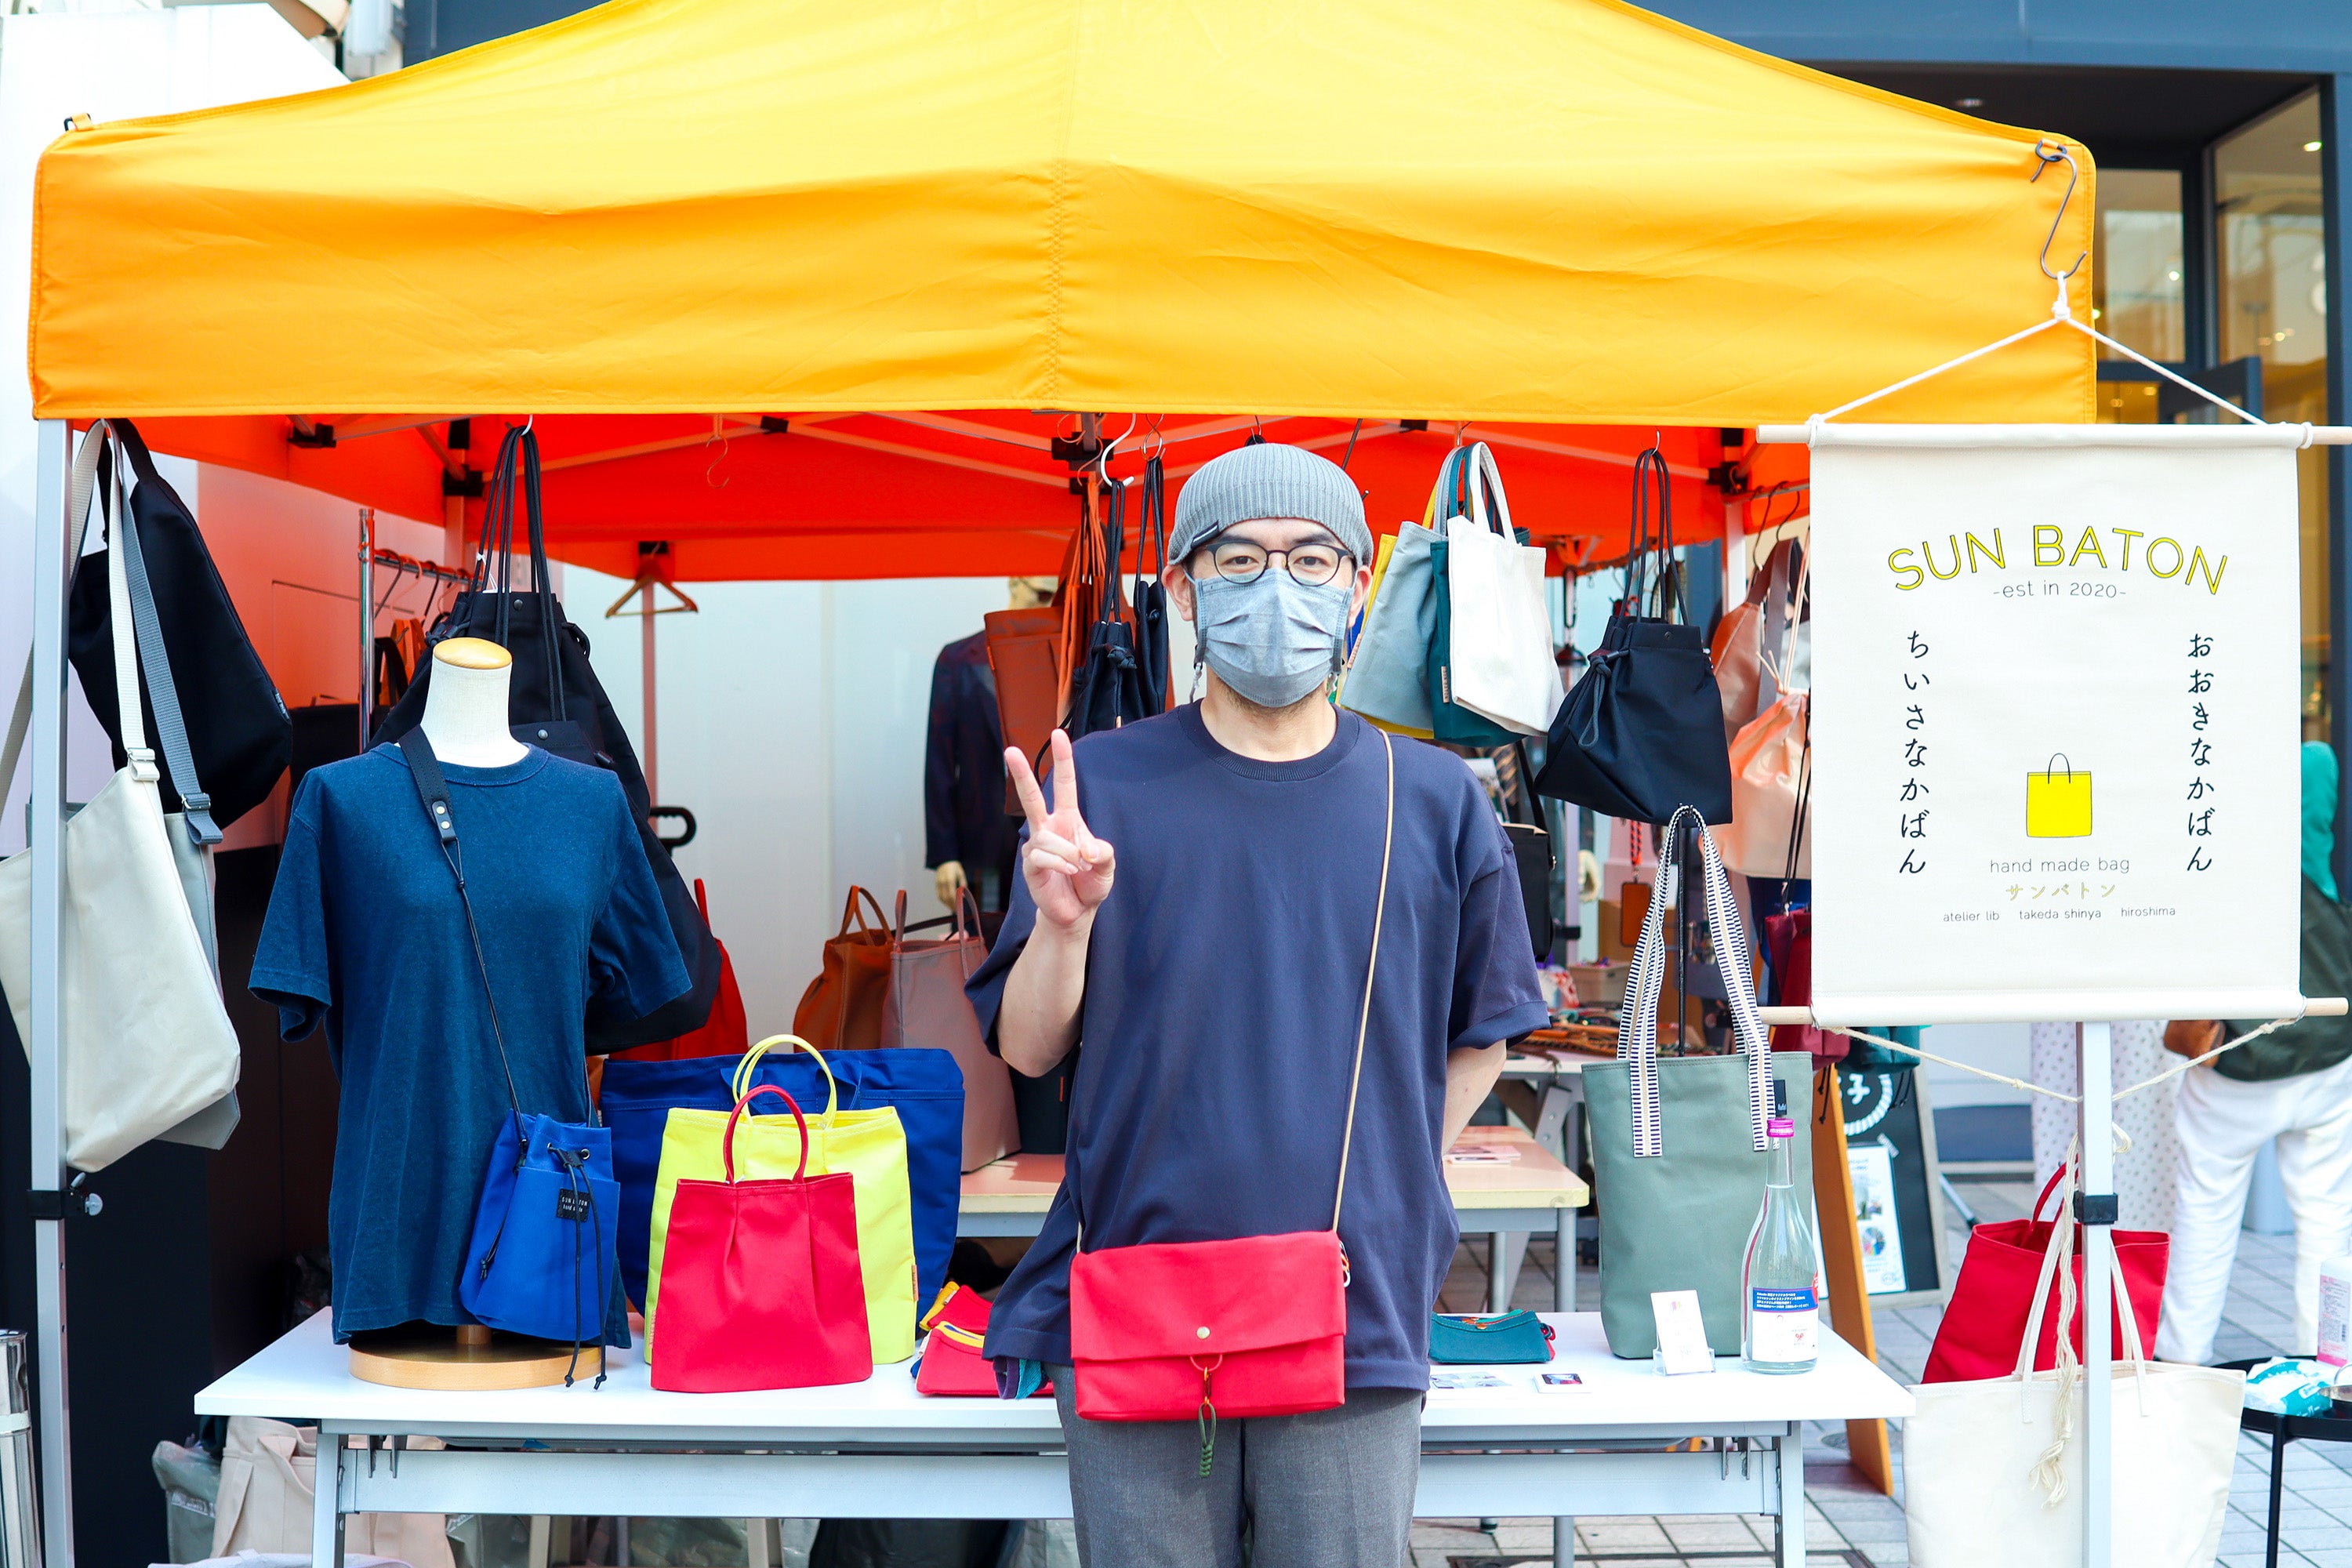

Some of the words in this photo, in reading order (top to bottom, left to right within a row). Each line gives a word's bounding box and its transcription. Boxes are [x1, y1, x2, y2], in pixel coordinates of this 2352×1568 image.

[1888, 528, 2005, 590] SUN
[2033, 524, 2227, 595] BATON
[2043, 579, 2060, 596] in
[1899, 630, 1930, 874] ちいさなかばん
[2187, 633, 2216, 872] おおきなかばん
[1990, 858, 2032, 873] hand
[2041, 857, 2090, 872] made
[2098, 857, 2129, 874] bag
[2005, 881, 2115, 902] サンバトン
[1943, 911, 1980, 922] atelier
[1986, 910, 2000, 921] lib
[2019, 909, 2059, 920] takeda
[2063, 908, 2102, 921] shinya
[2121, 906, 2176, 917] hiroshima
